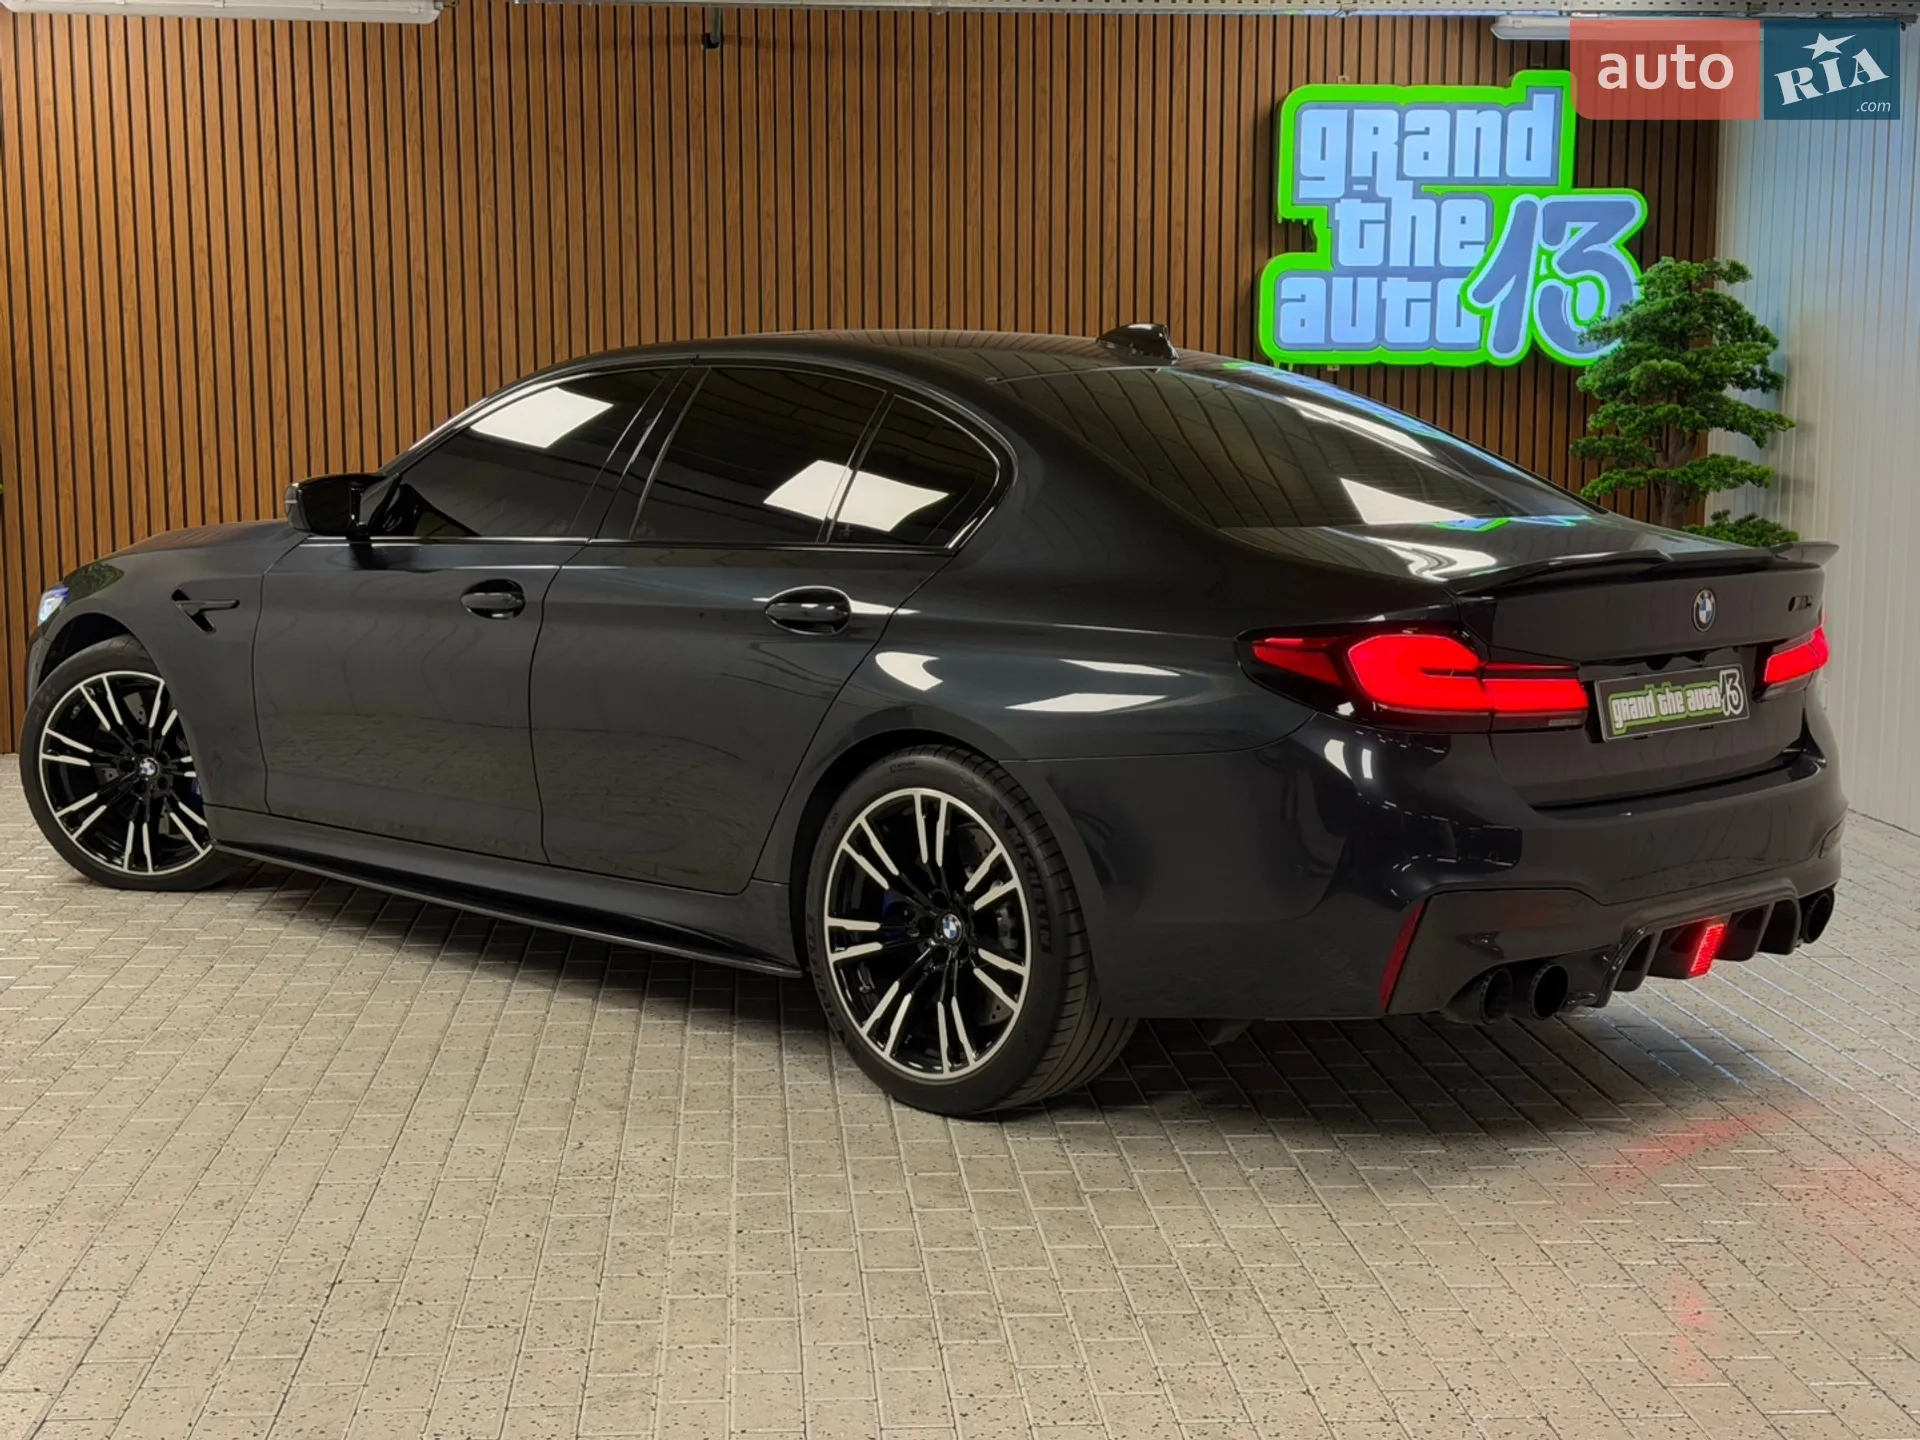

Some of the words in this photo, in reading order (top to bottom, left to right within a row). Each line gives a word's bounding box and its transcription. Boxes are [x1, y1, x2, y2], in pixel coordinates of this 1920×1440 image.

[1335, 182, 1487, 268] the
[1279, 277, 1481, 345] auto
[1468, 194, 1642, 359] 13
[1657, 687, 1686, 716] the
[1686, 686, 1721, 712] auto
[1719, 668, 1744, 717] 13
